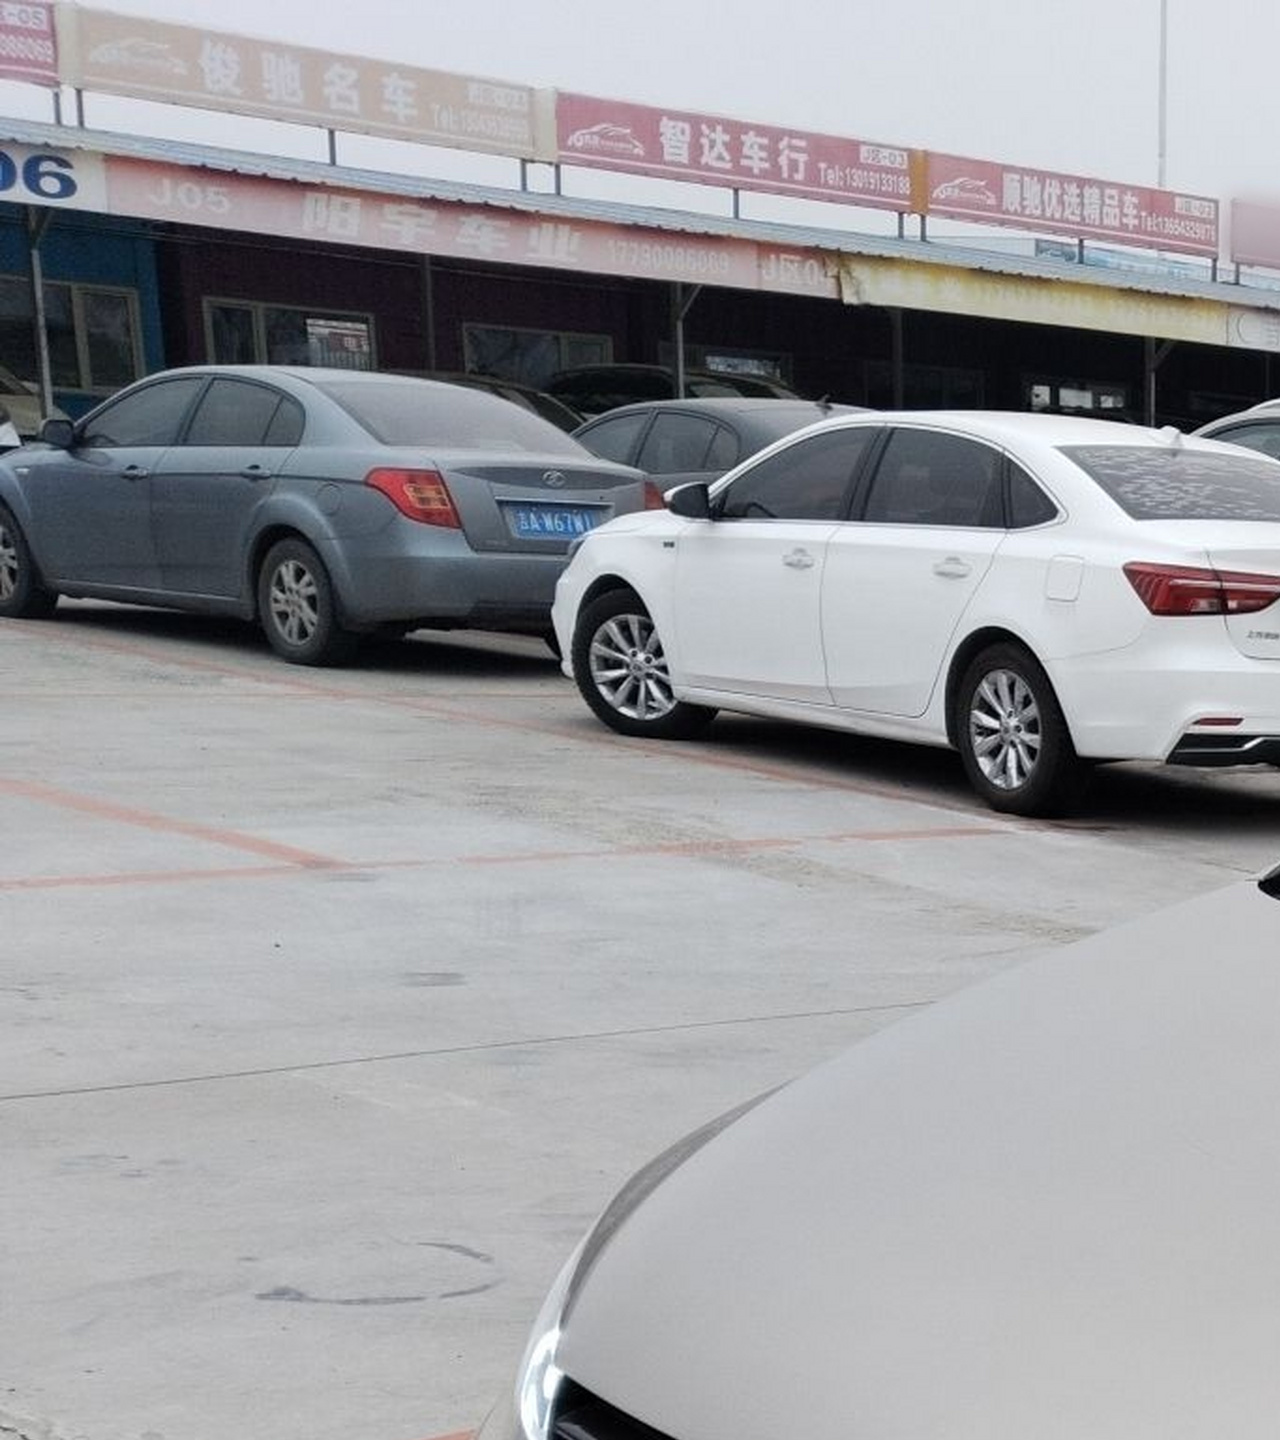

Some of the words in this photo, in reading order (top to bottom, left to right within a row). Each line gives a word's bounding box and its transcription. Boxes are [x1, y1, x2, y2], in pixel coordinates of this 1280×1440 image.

[659, 115, 809, 181] 智达车行
[1002, 172, 1139, 231] 顺驰优选精品车
